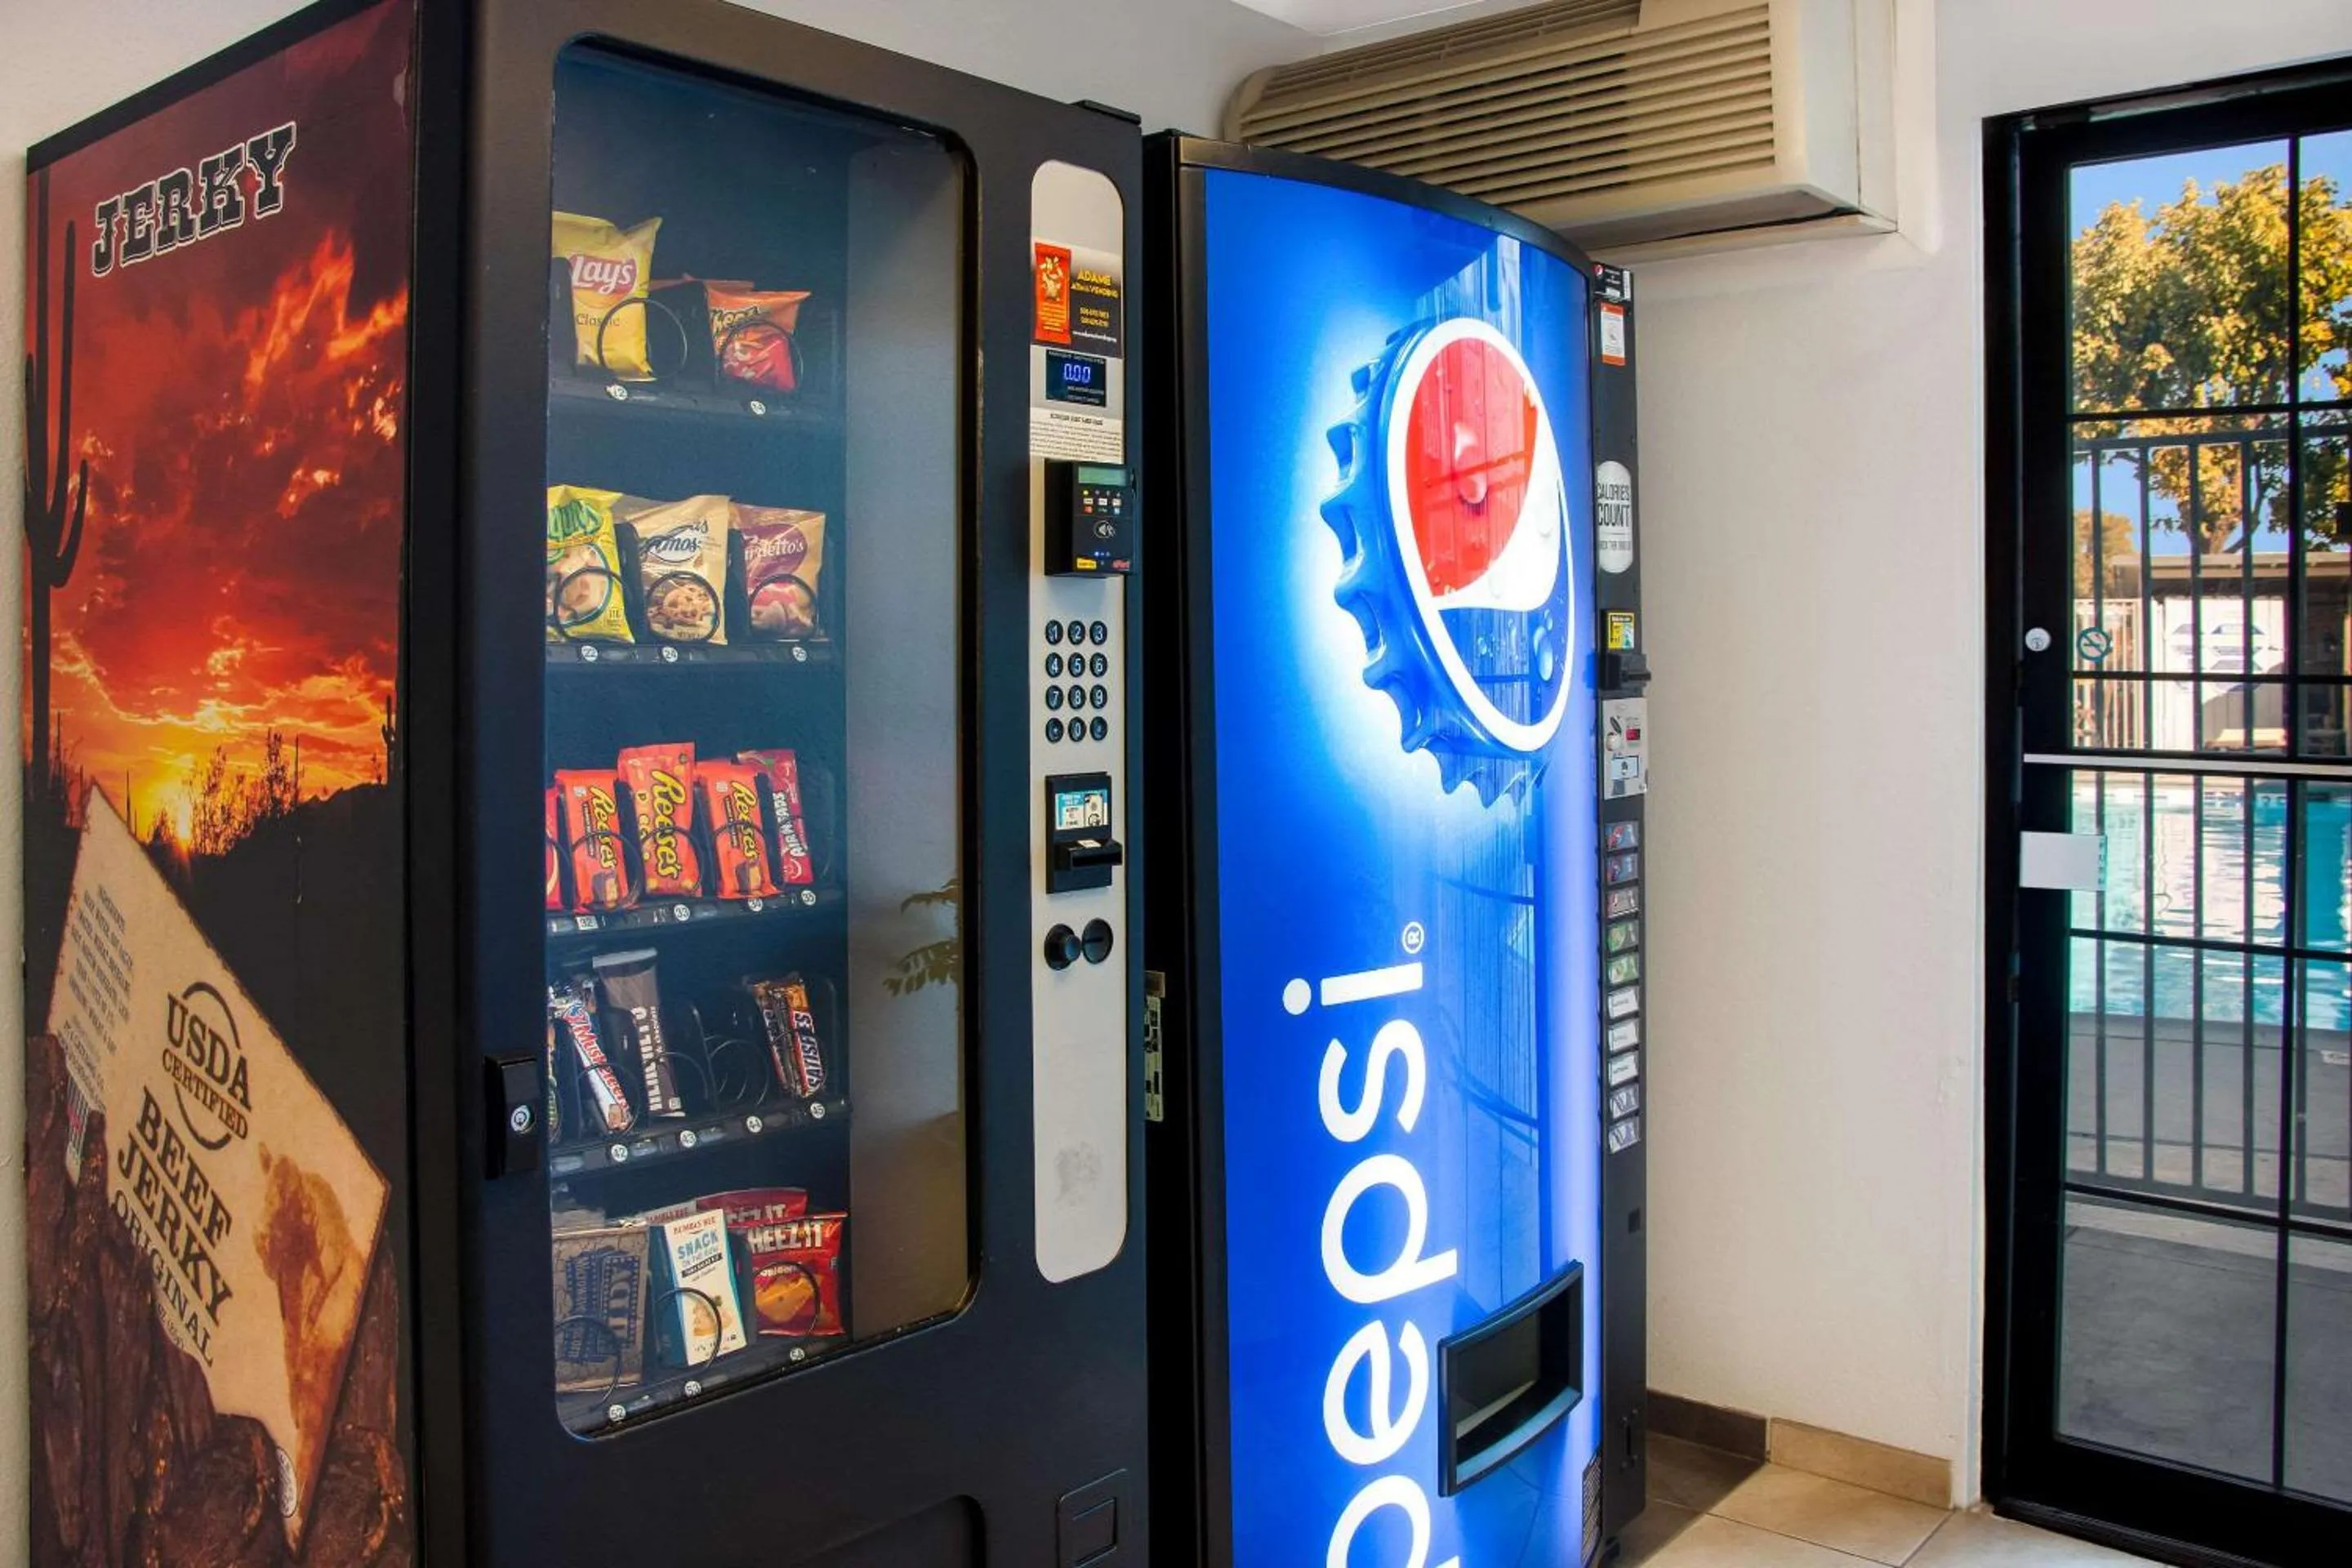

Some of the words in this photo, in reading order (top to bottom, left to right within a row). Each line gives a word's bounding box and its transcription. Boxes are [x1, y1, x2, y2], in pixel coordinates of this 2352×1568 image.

[91, 120, 297, 278] JERKY
[571, 254, 633, 295] Lay's
[577, 313, 621, 327] Claic
[1597, 482, 1630, 501] CALORIES
[1598, 503, 1630, 528] COUNT
[590, 786, 618, 869] Reese's
[651, 769, 683, 880] Reese's
[730, 780, 760, 862] Reese's
[167, 992, 252, 1113] USDA
[794, 1011, 823, 1090] SATISFES
[163, 1048, 248, 1140] CERTIFIED
[136, 1085, 232, 1250] BEEF
[118, 1130, 234, 1327] JERKY
[678, 1230, 719, 1259] SNACK
[747, 1220, 824, 1254] HEEZ-IT
[1281, 961, 1460, 1568] pepsi
[110, 1190, 214, 1368] ORIGINAL
